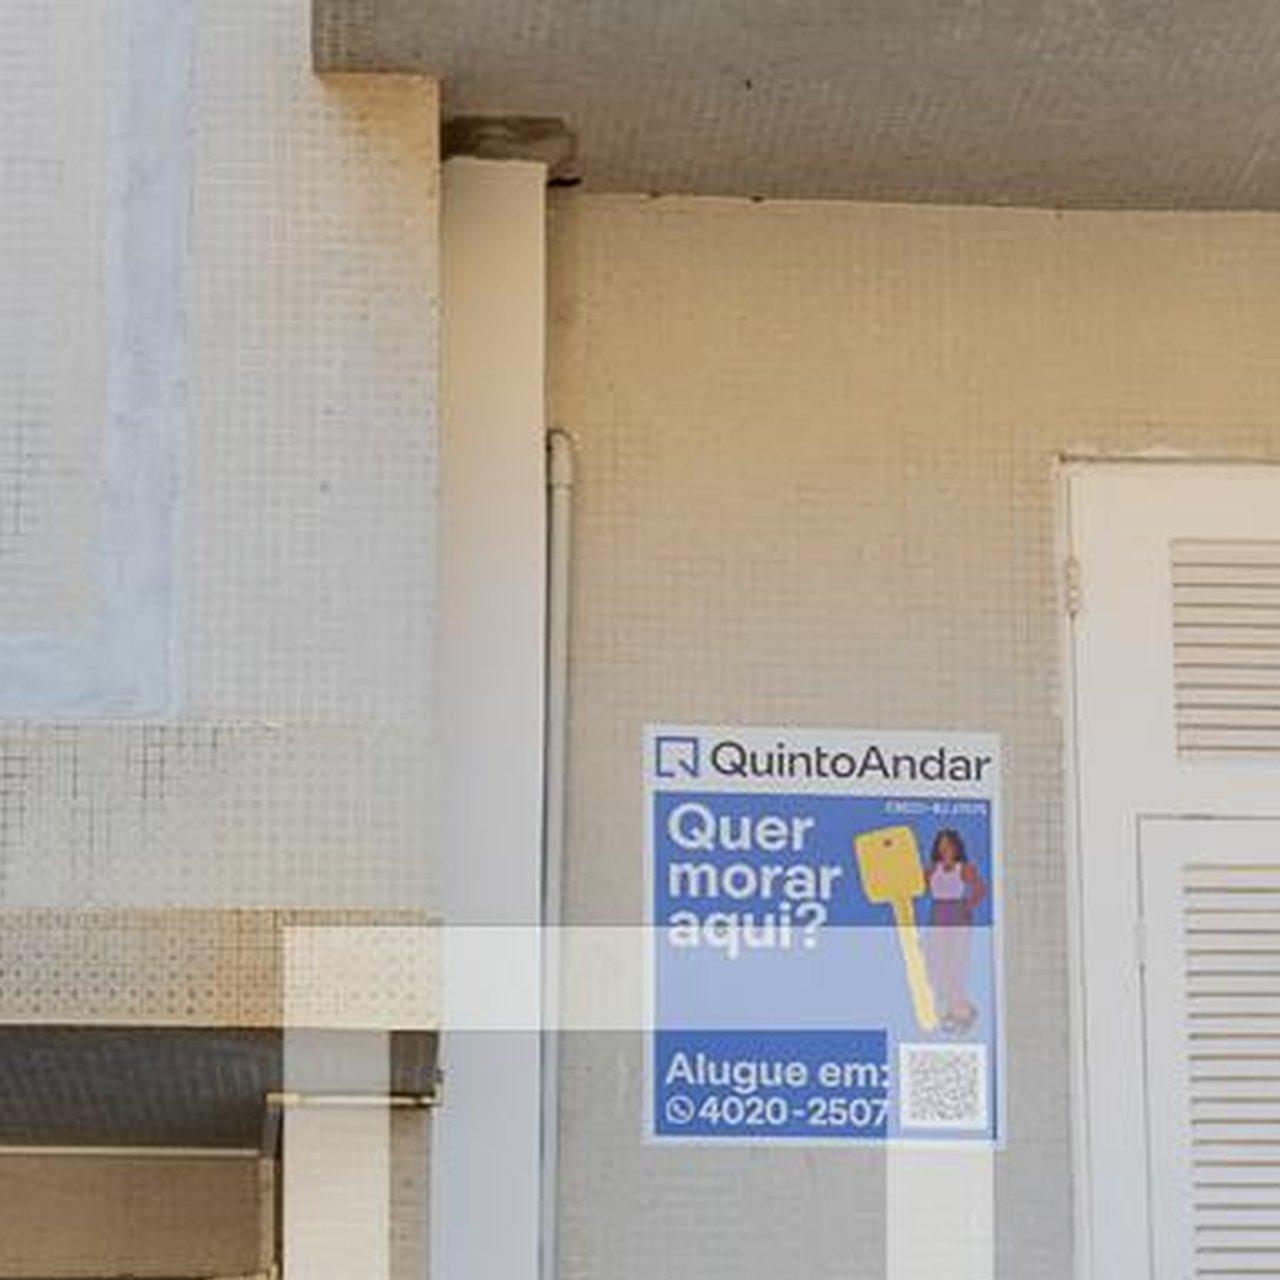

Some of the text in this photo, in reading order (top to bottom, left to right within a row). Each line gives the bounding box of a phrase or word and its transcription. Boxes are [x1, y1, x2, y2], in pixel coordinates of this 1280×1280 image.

[711, 740, 991, 782] QuintoAndar
[667, 803, 814, 851] Quer
[668, 861, 842, 900] morar
[667, 904, 827, 958] aqui?
[665, 1052, 890, 1092] Alugue em:
[699, 1097, 889, 1125] 4020-2507
